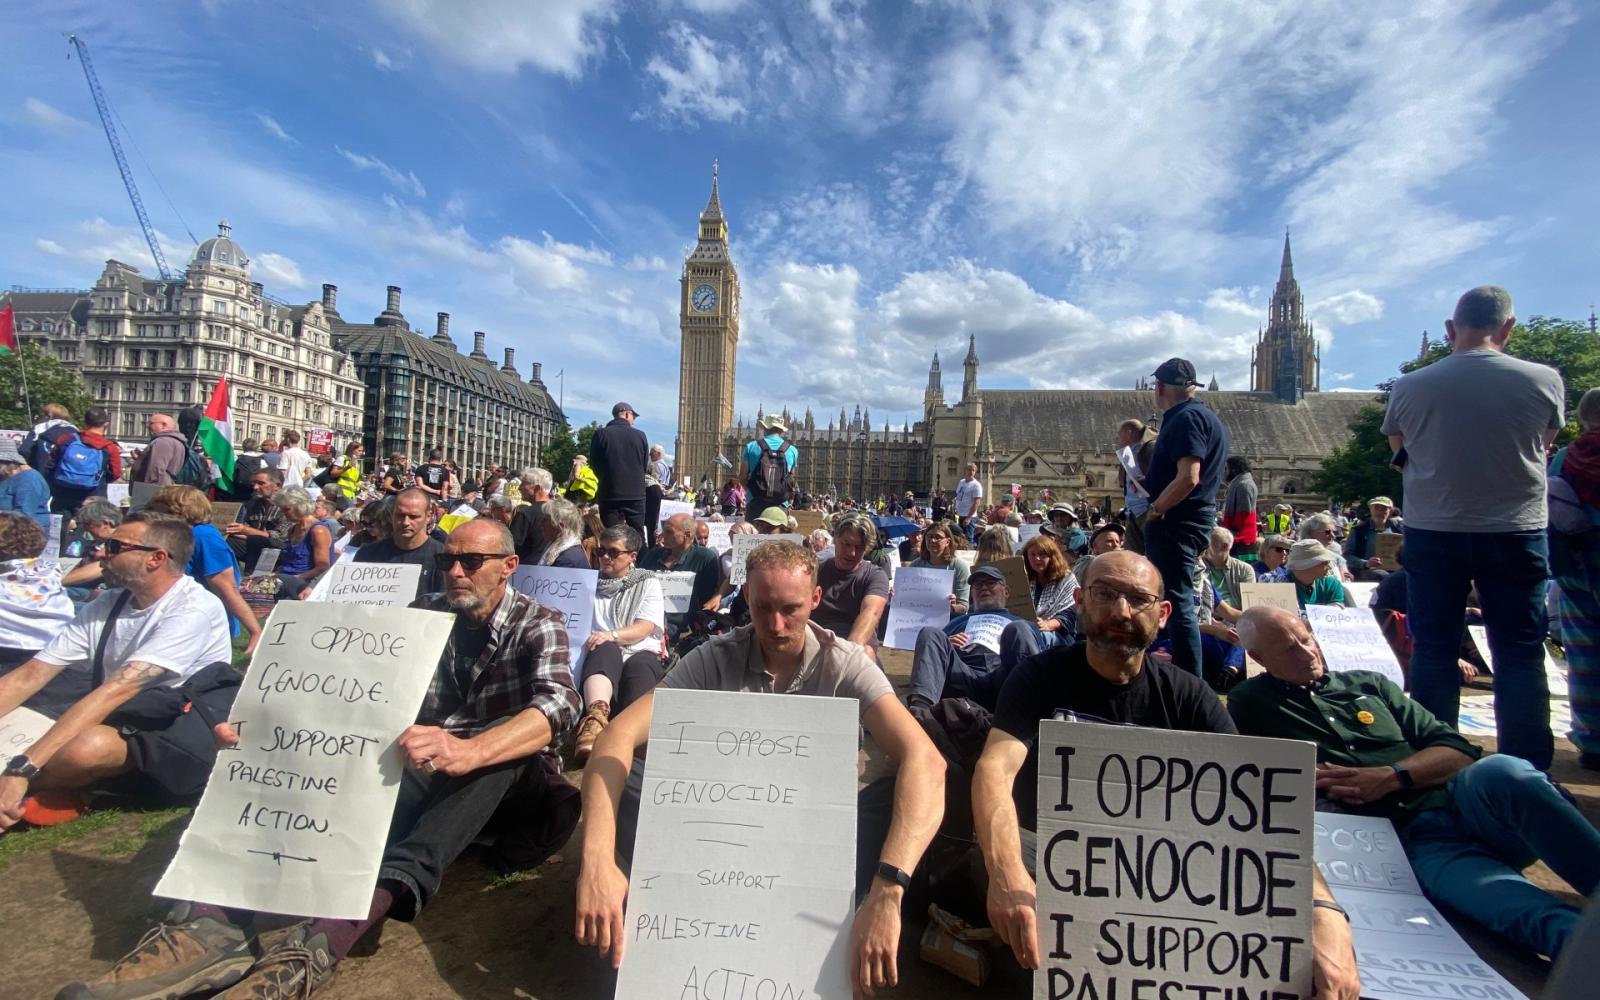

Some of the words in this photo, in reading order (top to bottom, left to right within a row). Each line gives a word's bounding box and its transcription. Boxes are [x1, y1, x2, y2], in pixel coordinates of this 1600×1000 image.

[332, 584, 401, 595] GENOCIDE
[351, 566, 402, 581] OPPOSE
[520, 576, 582, 599] OPPOSE
[269, 621, 296, 647] I
[311, 625, 407, 658] OPPOSE
[258, 662, 389, 704] GENOCIDE.
[230, 720, 248, 751] I
[260, 726, 380, 758] SUPPORT
[668, 721, 696, 756] I
[715, 730, 811, 758] OPPOSE
[227, 760, 338, 795] PALESTINE
[653, 780, 799, 806] GENOCIDE
[1054, 746, 1076, 812] I
[1097, 753, 1303, 834] OPPOSE
[238, 801, 333, 838] ACTION.
[1314, 823, 1388, 852] POSE
[640, 875, 661, 890] I
[696, 869, 781, 890] SUPPORT
[1044, 829, 1300, 918] GENOCIDE
[636, 912, 760, 942] PALESTINE
[1049, 913, 1074, 959] I
[1096, 919, 1304, 983] SUPPORT
